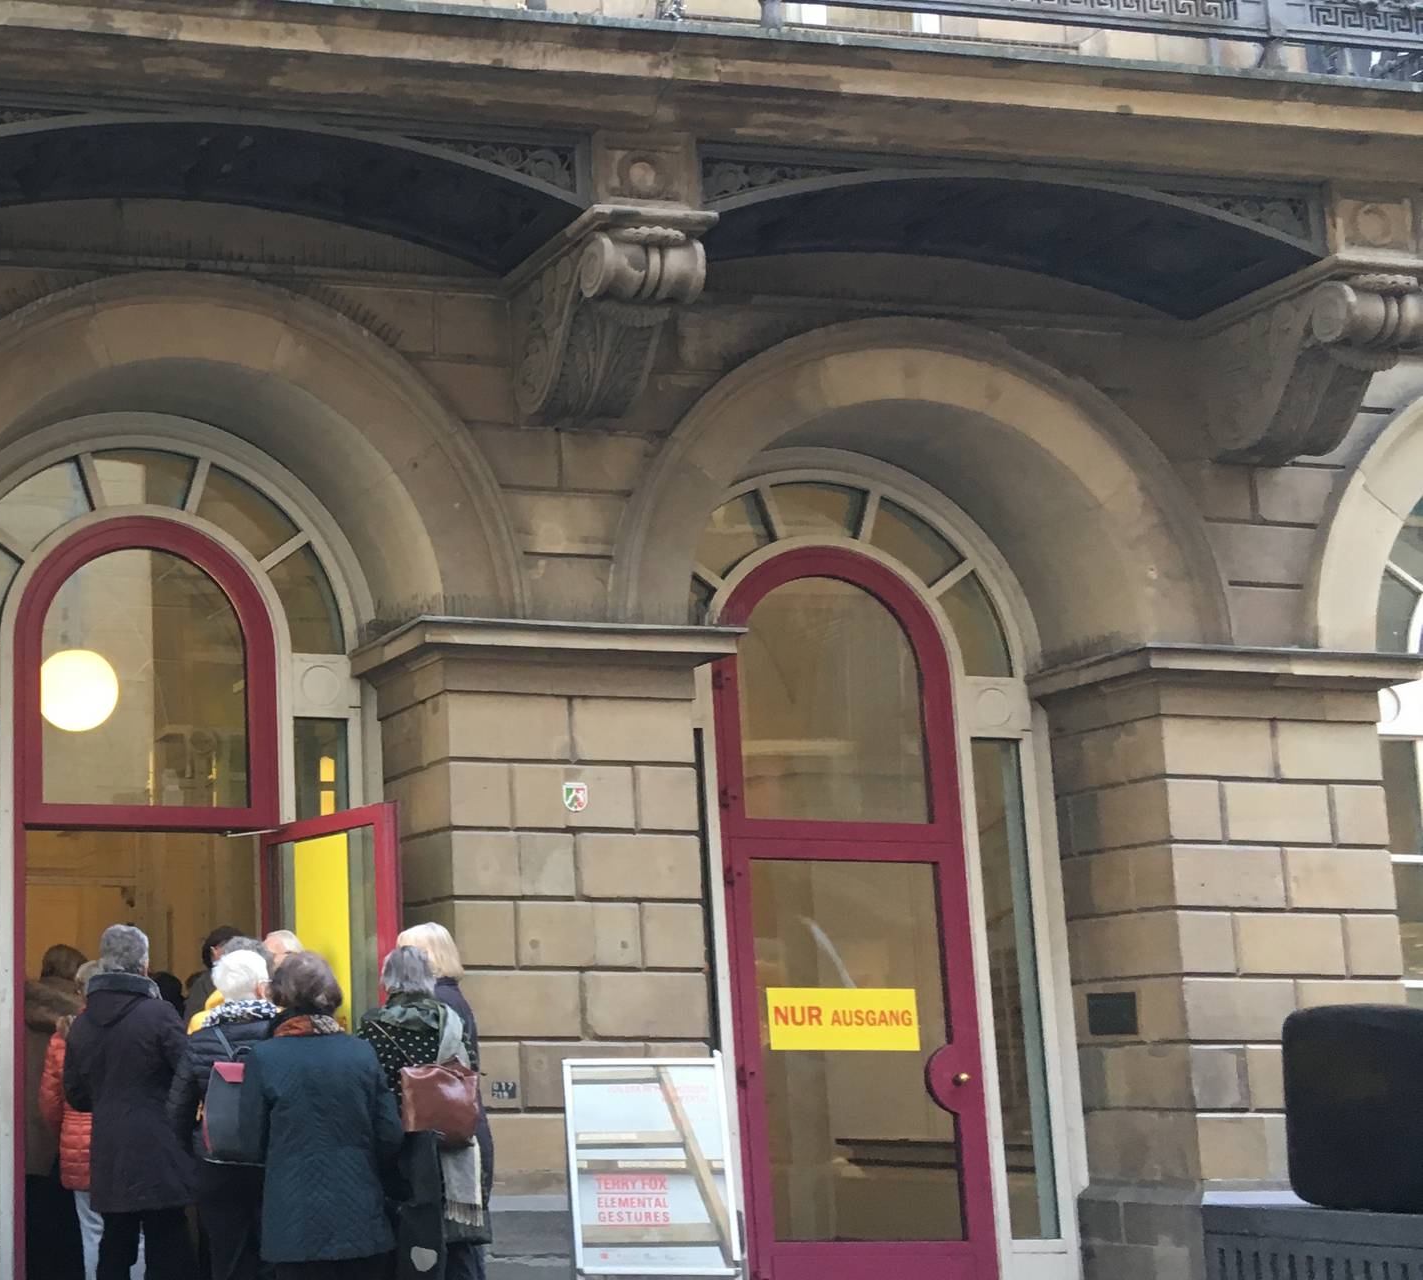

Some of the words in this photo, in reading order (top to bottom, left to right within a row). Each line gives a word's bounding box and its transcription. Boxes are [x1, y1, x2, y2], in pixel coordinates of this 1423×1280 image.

[773, 1006, 823, 1026] NUR
[831, 1009, 913, 1027] AUSGANG
[596, 1177, 637, 1190] TERRY
[641, 1176, 668, 1190] FOX
[597, 1197, 669, 1208] ELEMENTAL
[597, 1211, 670, 1222] GESTURES
